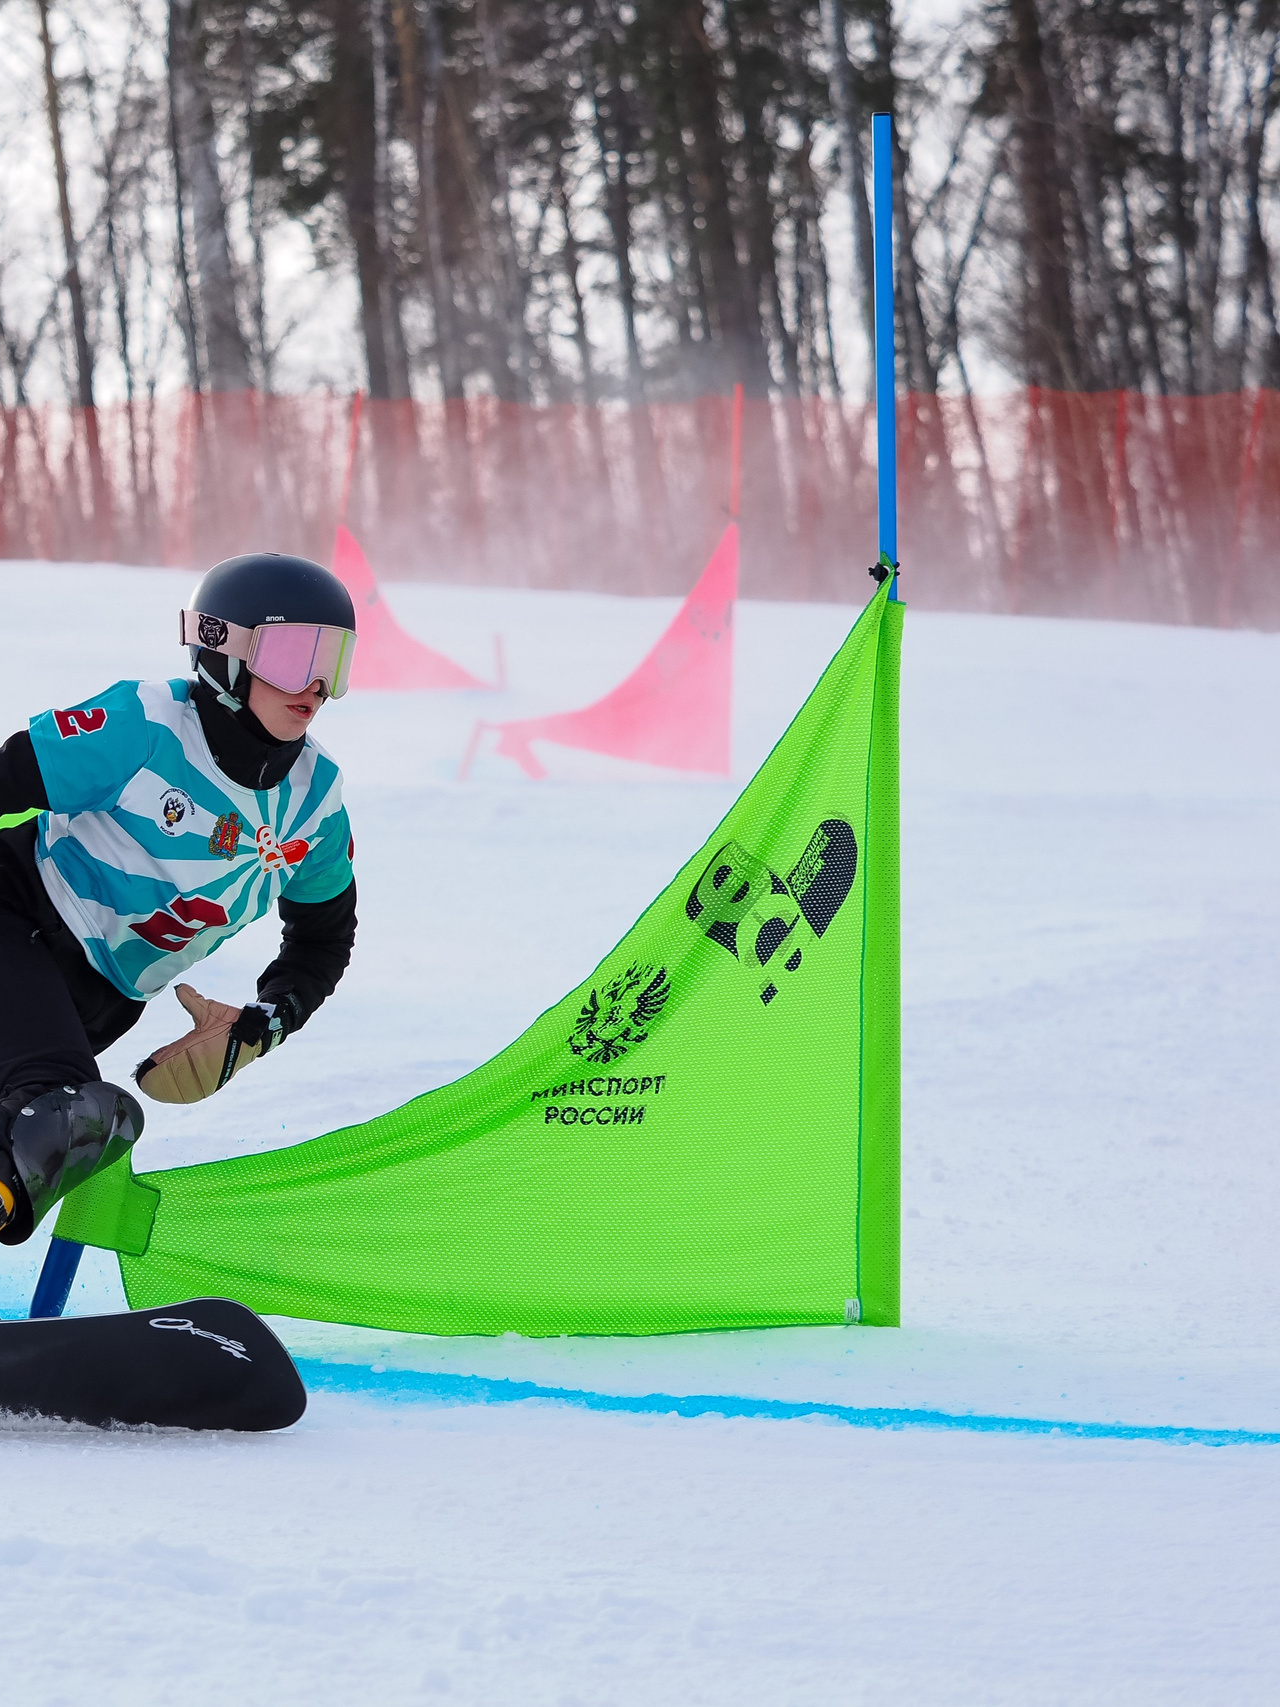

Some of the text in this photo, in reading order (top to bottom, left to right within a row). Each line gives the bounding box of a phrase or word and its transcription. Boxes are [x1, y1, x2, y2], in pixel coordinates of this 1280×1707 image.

[54, 708, 107, 739] 2
[796, 858, 825, 901] РОССИИ
[129, 896, 229, 952] 2
[531, 1075, 666, 1102] МИНСПОРТ
[544, 1105, 646, 1125] РОССИИ
